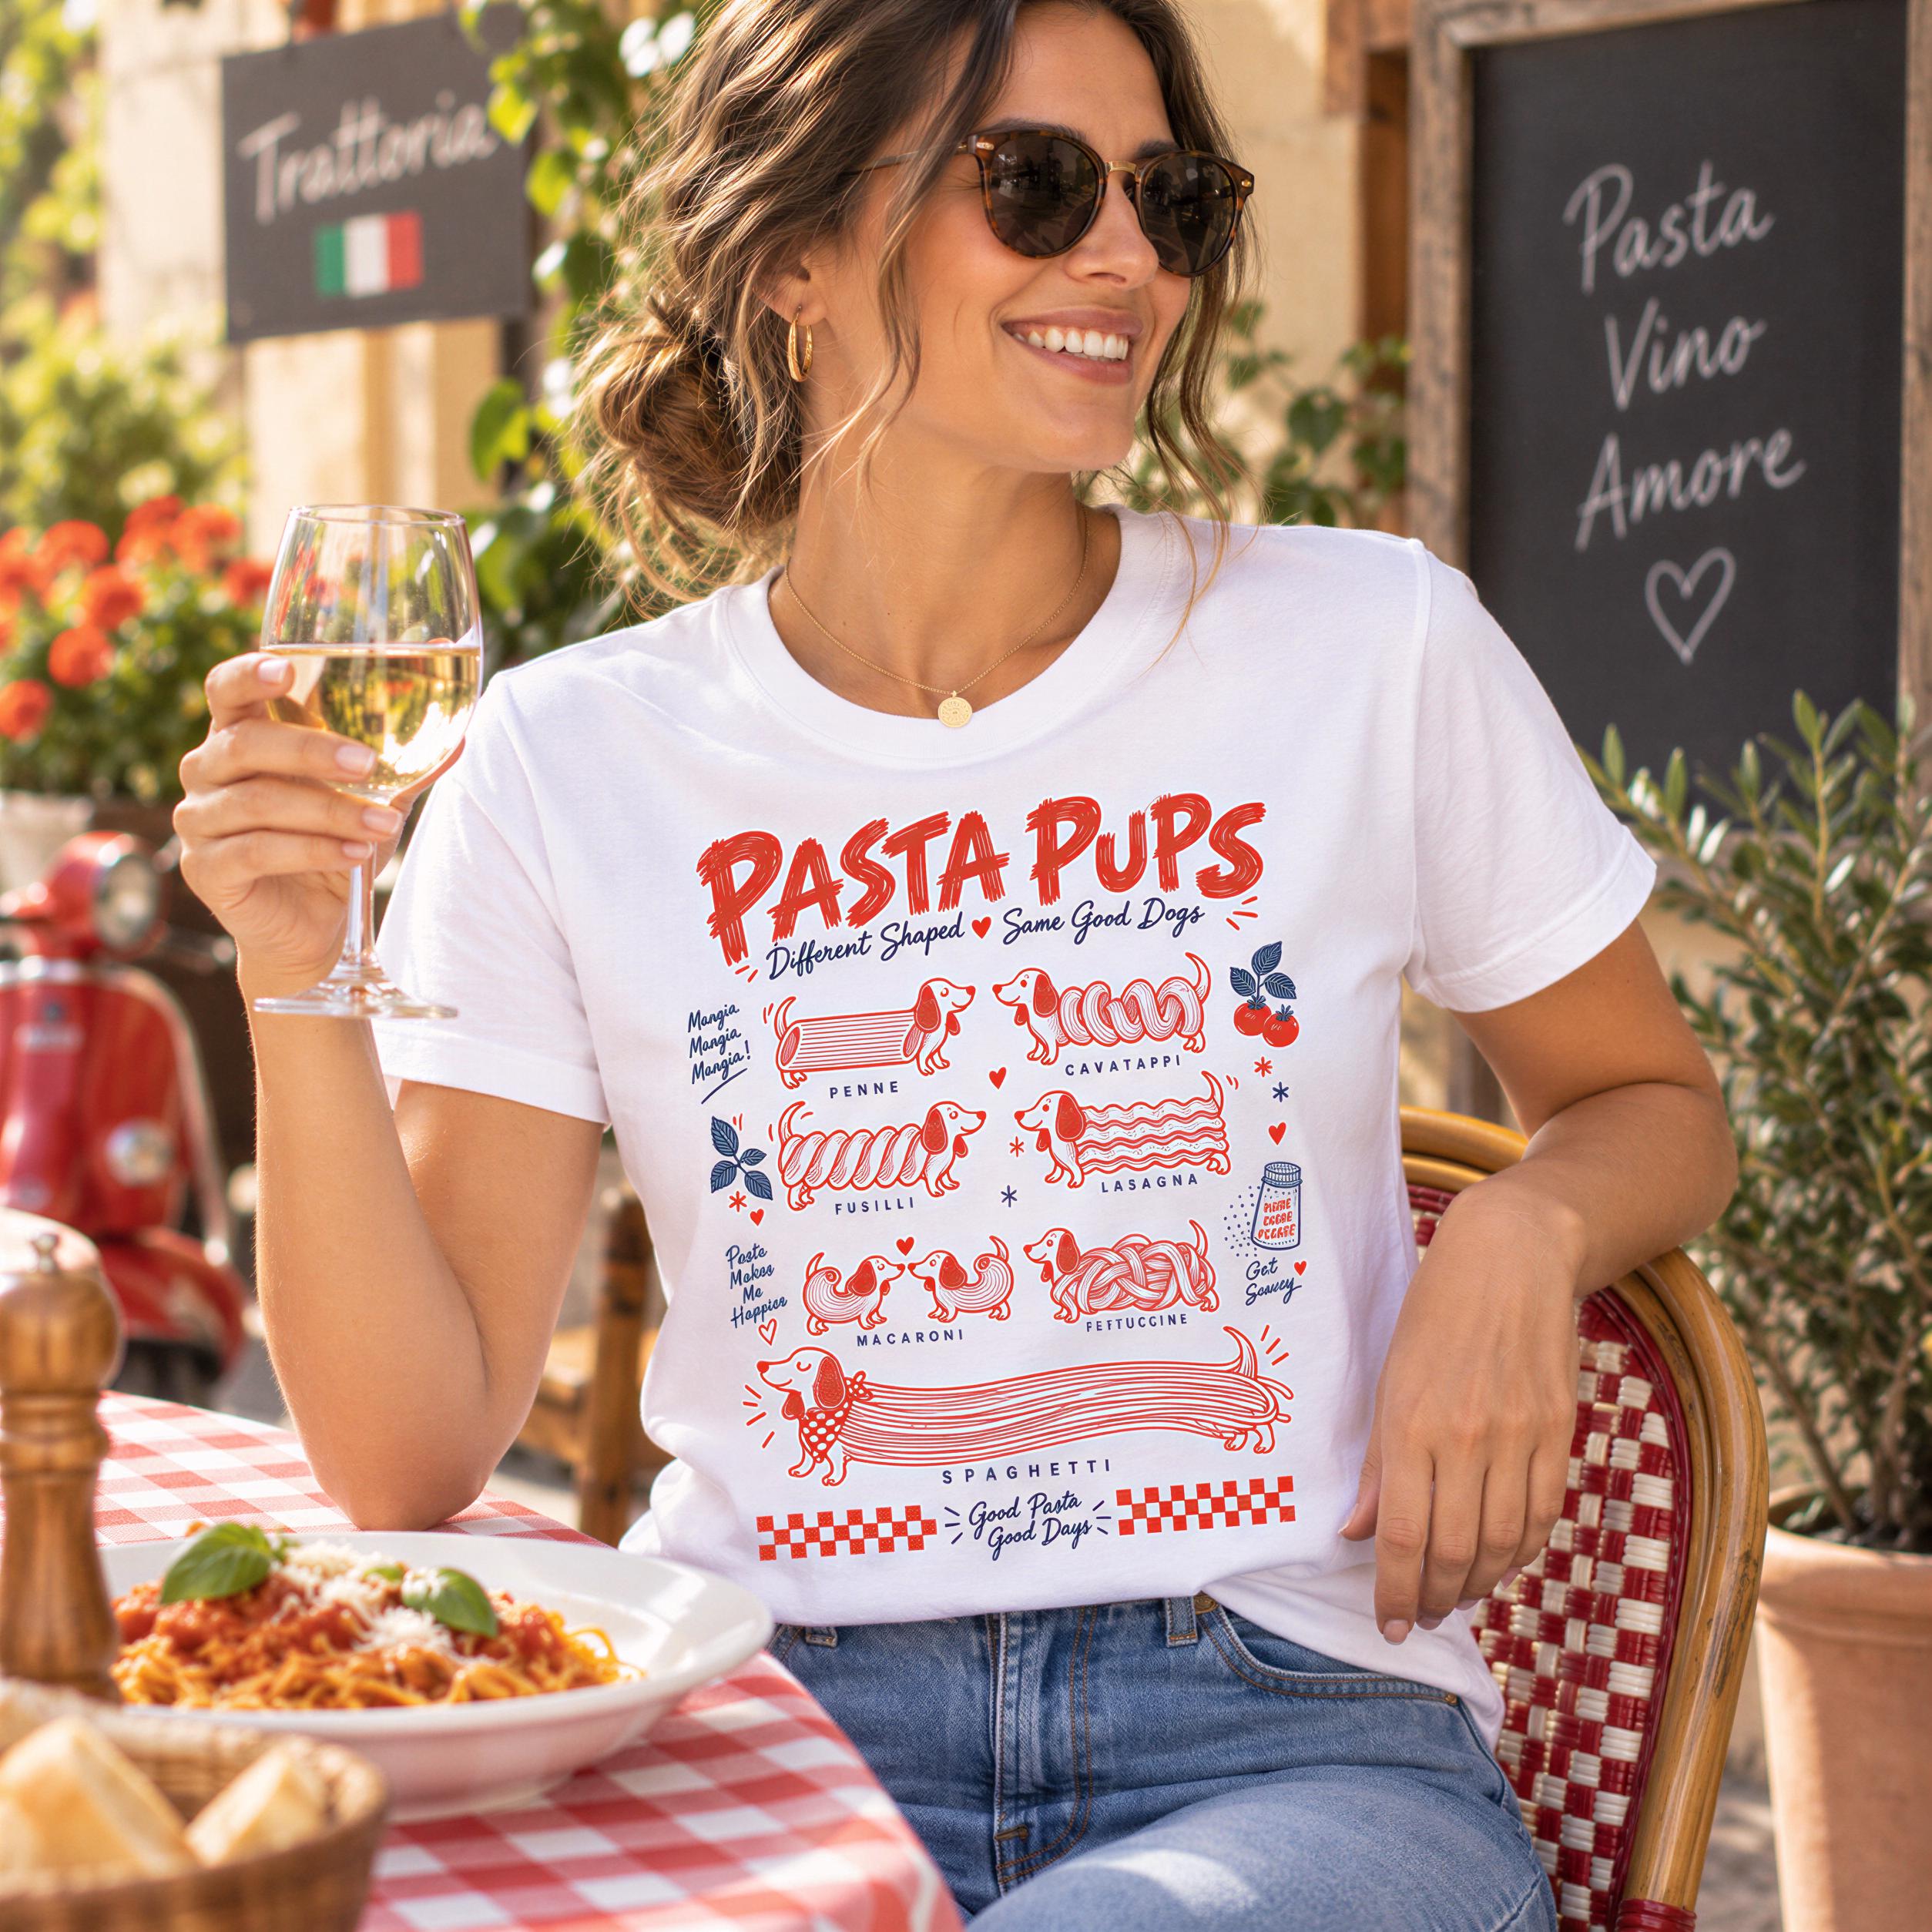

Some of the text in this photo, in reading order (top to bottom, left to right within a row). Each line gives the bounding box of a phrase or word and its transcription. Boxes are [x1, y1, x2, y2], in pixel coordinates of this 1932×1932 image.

[237, 89, 499, 225] Trattoria
[1562, 159, 1775, 295] Pasta
[1605, 297, 1766, 411] Vino
[1575, 428, 1806, 552] Amore
[696, 793, 1266, 966] PASTA PUPS
[765, 897, 1206, 980] Different Shaped Same Good Dogs
[1065, 1054, 1181, 1076] CAVATAPPI
[829, 1081, 899, 1099] PENNE
[834, 1196, 914, 1216] FUSILLI
[1101, 1173, 1198, 1193] LASAGNA
[857, 1329, 964, 1347] MACARONI
[942, 1458, 1111, 1484] SPAGHETTI
[968, 1490, 1082, 1541] Good Pasta
[988, 1517, 1093, 1561] Good Days
